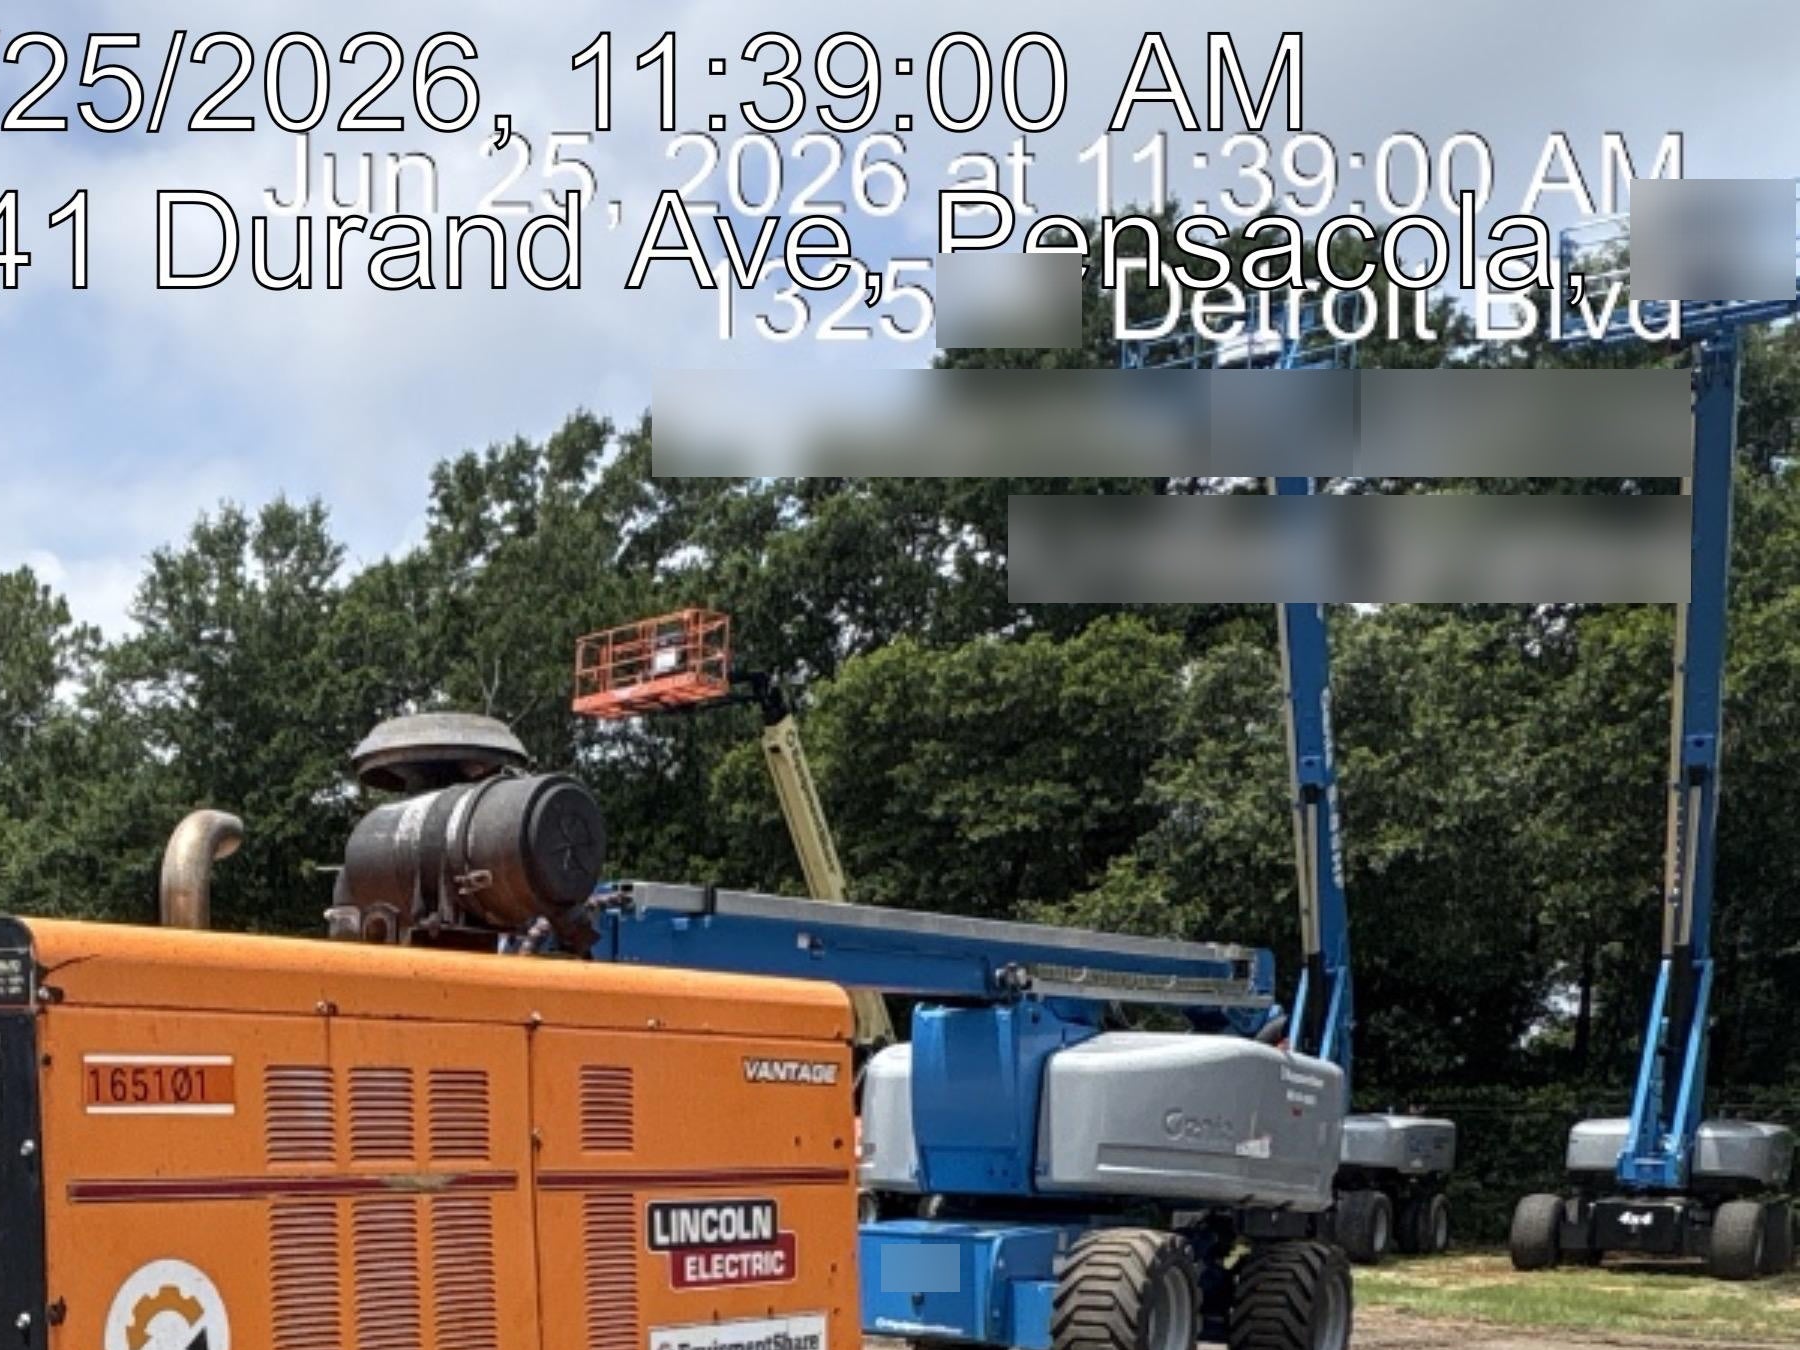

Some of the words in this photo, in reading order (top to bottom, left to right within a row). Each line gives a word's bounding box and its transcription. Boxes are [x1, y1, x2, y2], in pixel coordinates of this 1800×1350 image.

[89, 1067, 207, 1103] 165101
[744, 1060, 838, 1084] VANTAGE
[653, 1206, 773, 1245] LINCOLN
[684, 1250, 786, 1282] ELECTRIC
